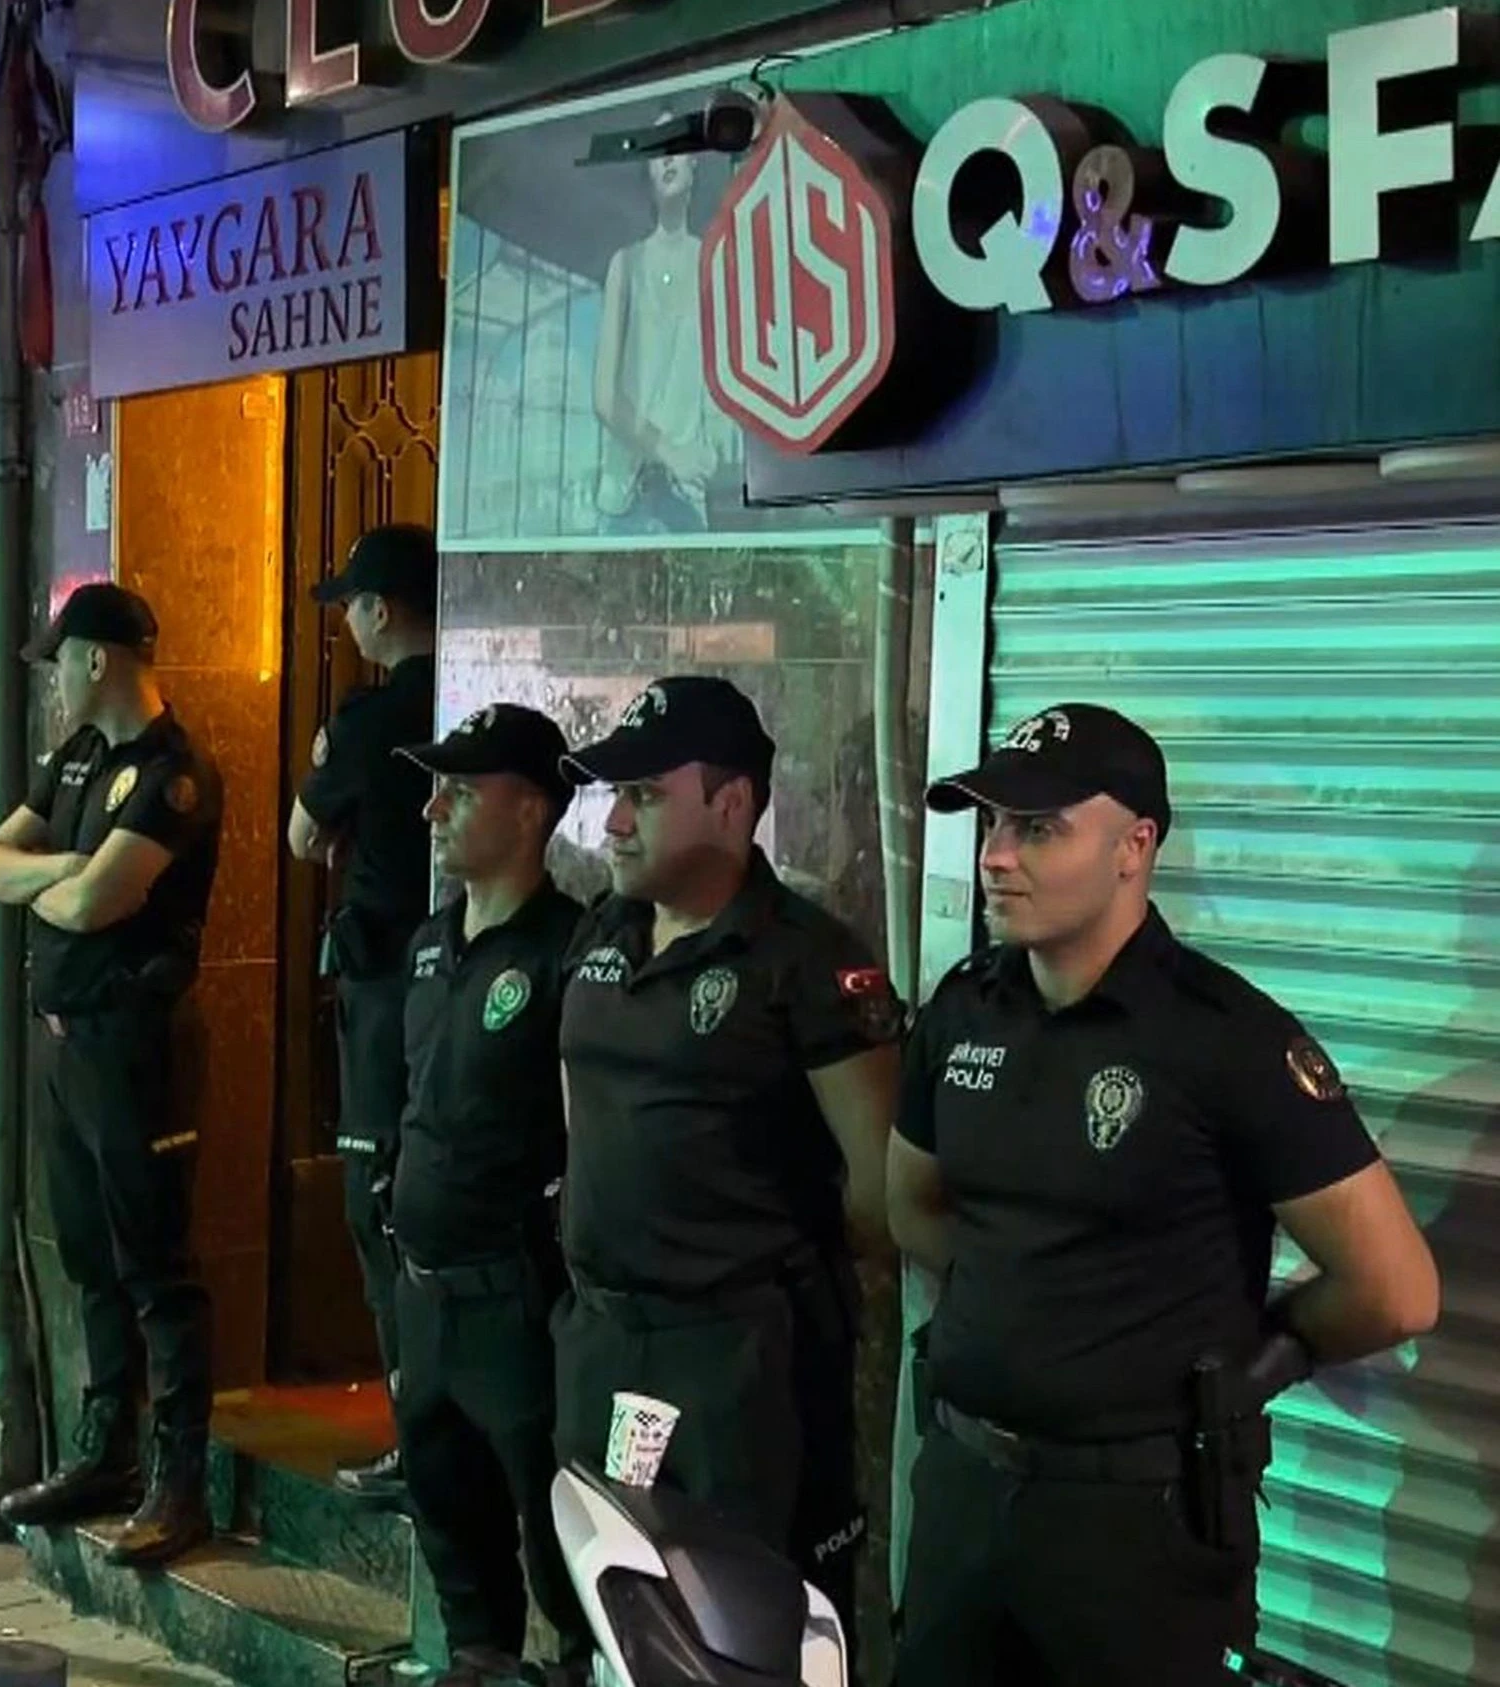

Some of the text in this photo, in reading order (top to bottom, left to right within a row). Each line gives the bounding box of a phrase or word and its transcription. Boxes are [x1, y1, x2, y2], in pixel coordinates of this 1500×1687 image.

[1327, 6, 1500, 265] F
[105, 171, 383, 316] YAYGARA
[228, 275, 384, 362] SAHNE
